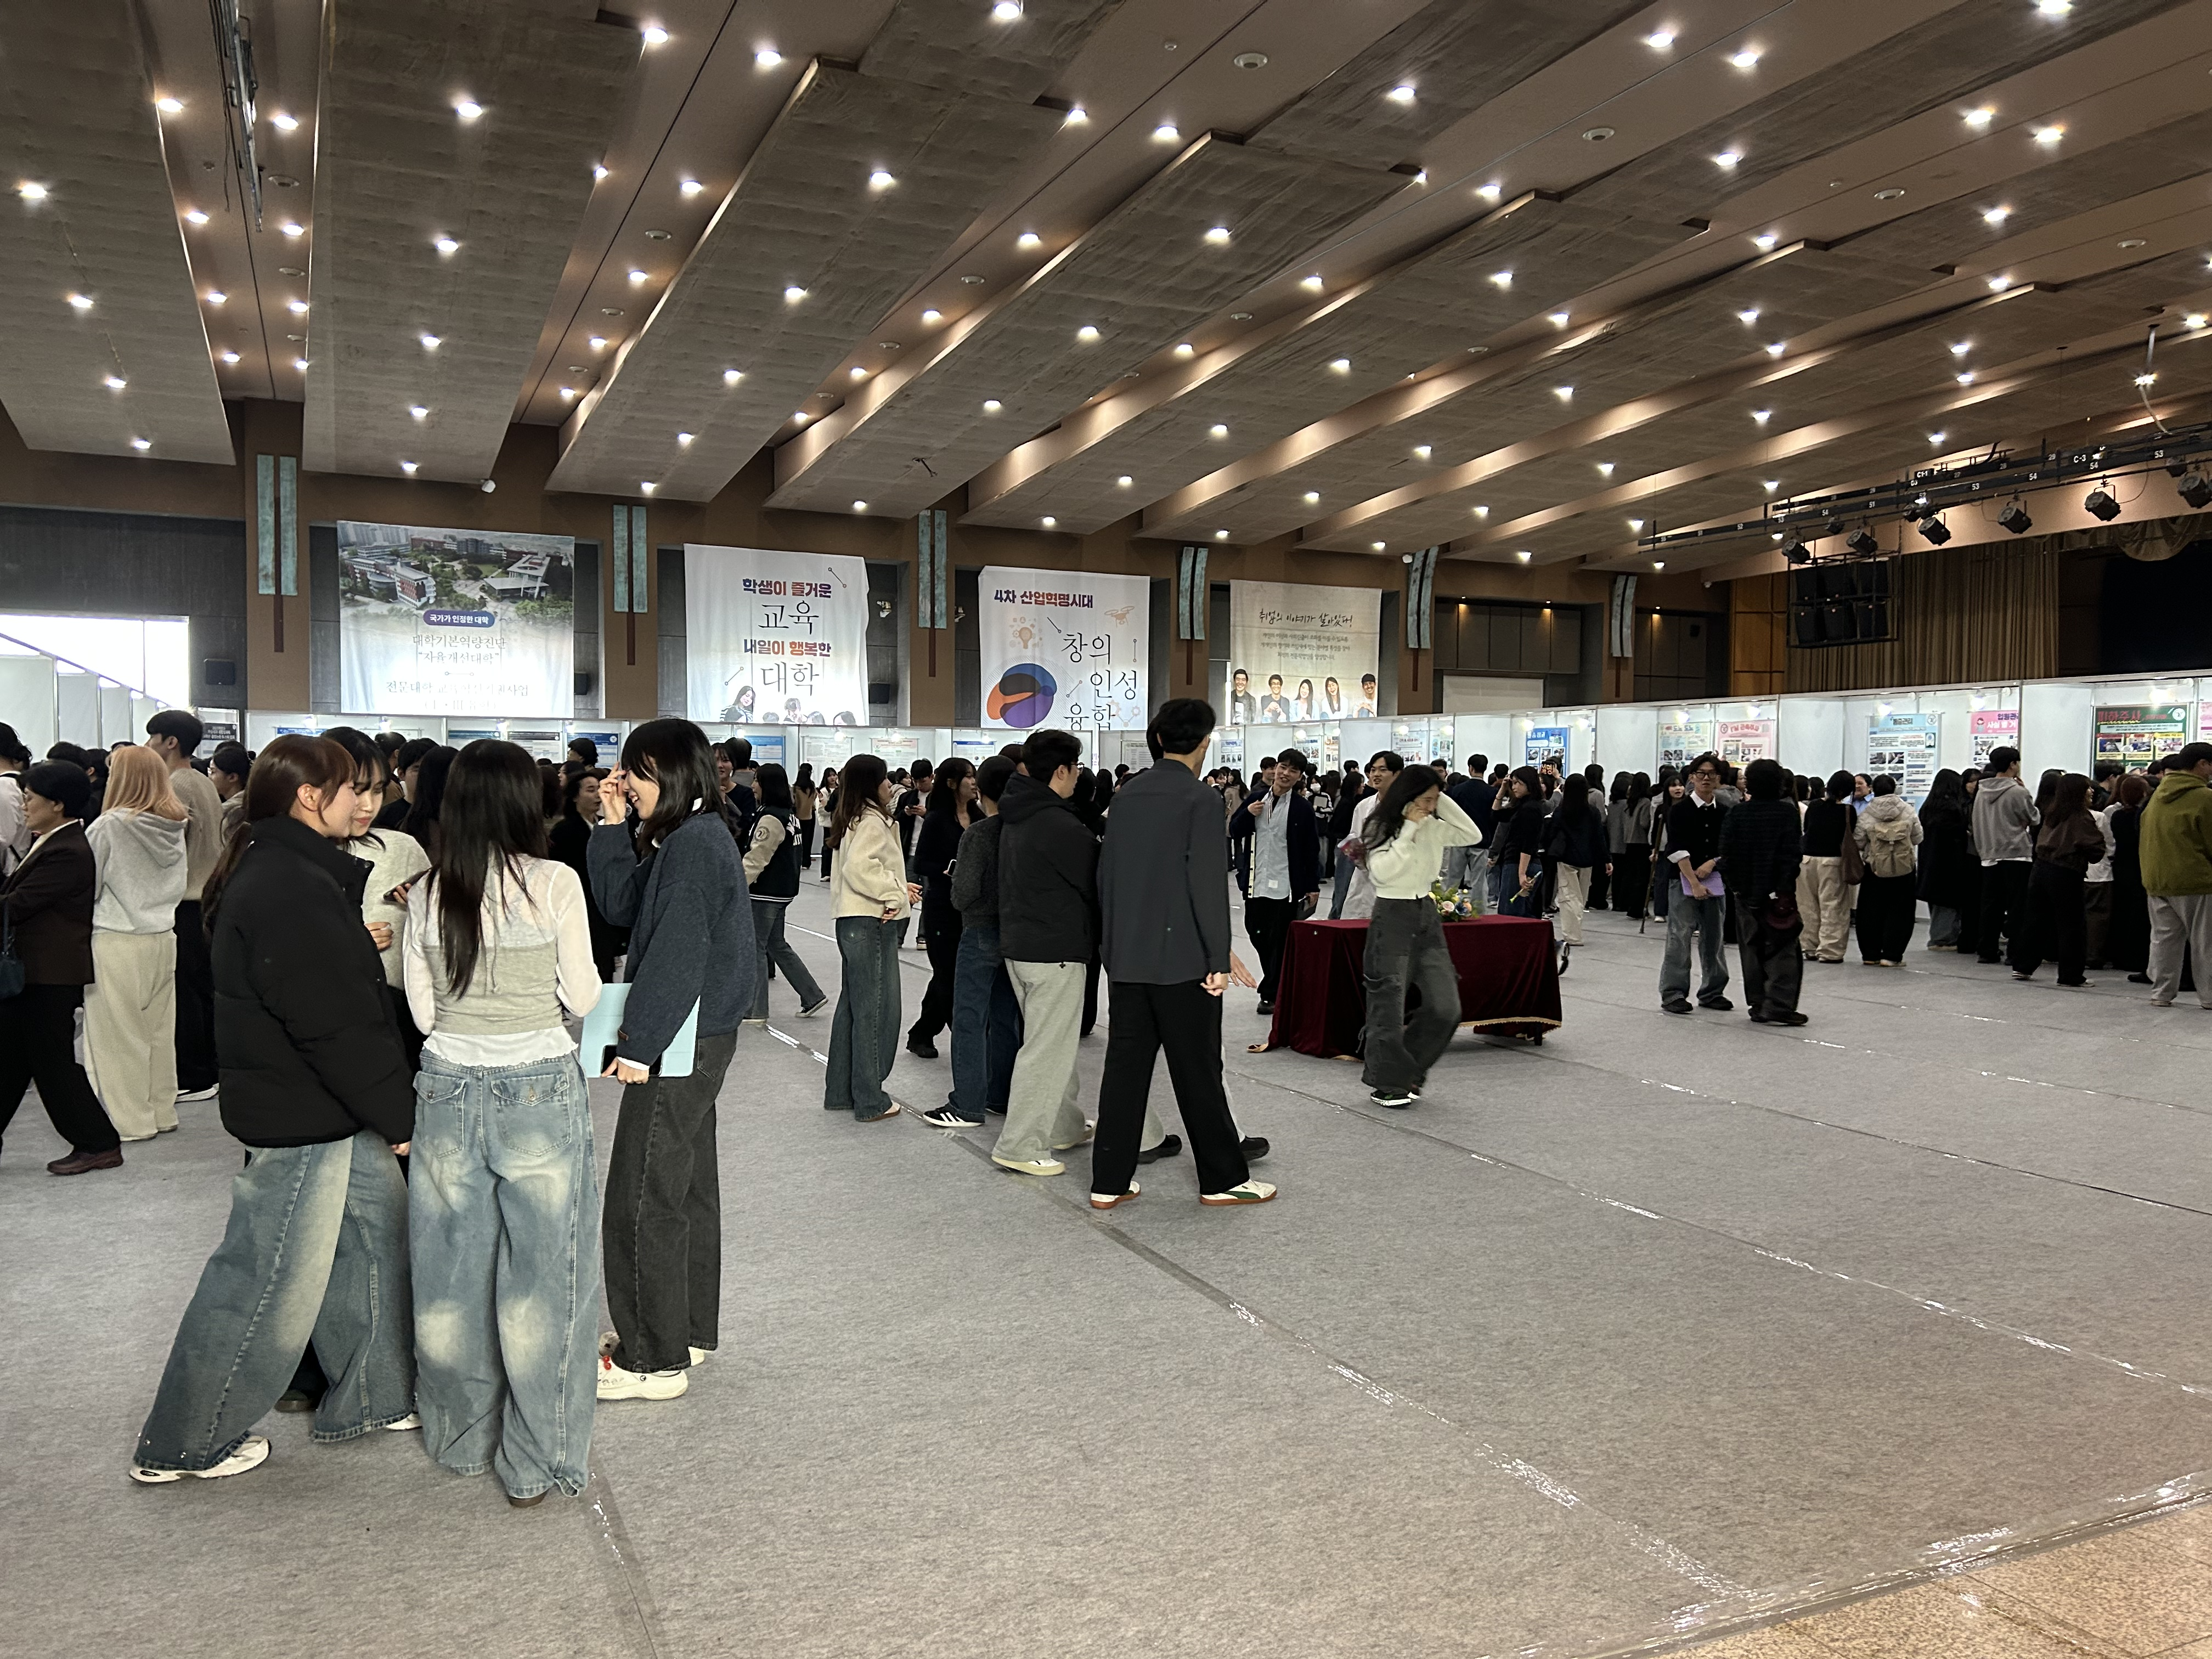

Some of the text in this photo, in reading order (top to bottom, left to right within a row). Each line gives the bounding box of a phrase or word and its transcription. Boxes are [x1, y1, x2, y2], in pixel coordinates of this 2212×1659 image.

[2073, 454, 2086, 464] C-3
[2154, 450, 2164, 459] 53
[2089, 462, 2098, 470] 54
[2029, 472, 2038, 481] 54
[1971, 483, 1980, 491] 53
[743, 578, 832, 599] 학생이 즐거운
[994, 589, 1093, 608] 4차 산업혁명시대
[430, 614, 489, 625] 국가가 인정한 대학
[758, 600, 820, 635] 교육
[1259, 608, 1283, 625] 취업의
[1286, 613, 1316, 624] 이야기가
[412, 634, 507, 650] 대학기본역량진단
[743, 638, 832, 658] 내일이 행복한
[1061, 632, 1111, 665] 창의
[386, 680, 433, 694] 전문대학
[760, 661, 820, 697] 대학
[1090, 669, 1137, 701] 인성
[1063, 702, 1116, 731] 융합
